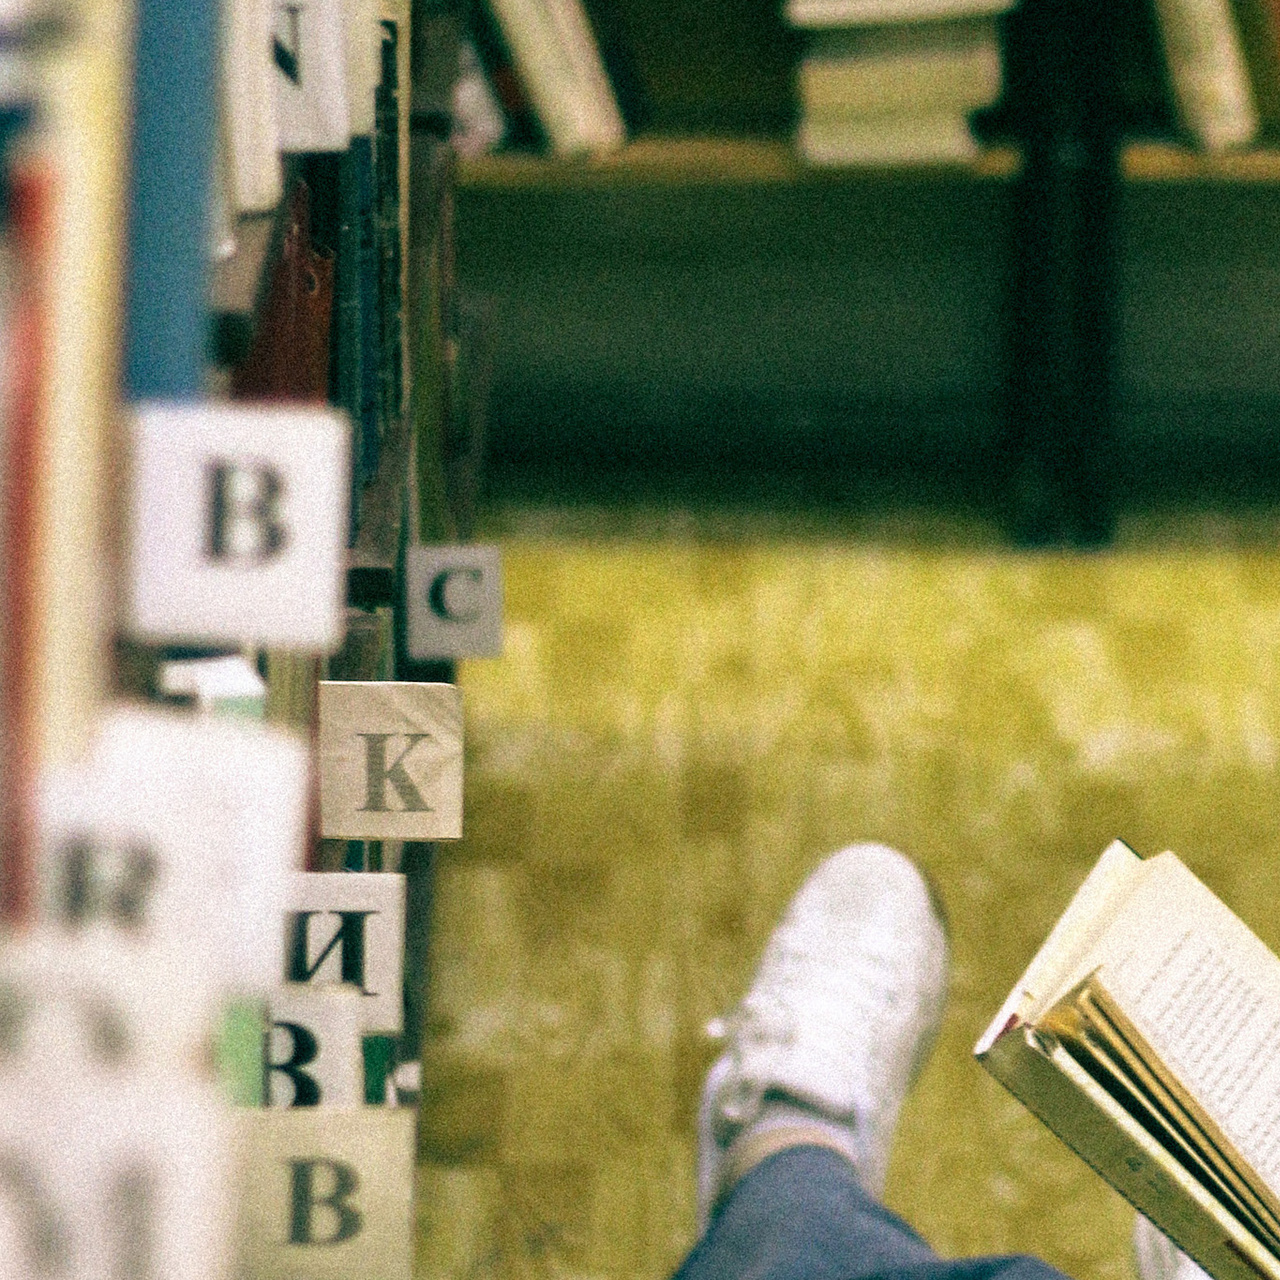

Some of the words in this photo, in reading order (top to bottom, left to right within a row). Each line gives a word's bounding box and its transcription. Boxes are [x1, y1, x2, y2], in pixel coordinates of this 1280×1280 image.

[201, 457, 290, 566] В
[428, 568, 483, 624] С
[356, 732, 434, 814] К
[286, 1156, 364, 1248] В
